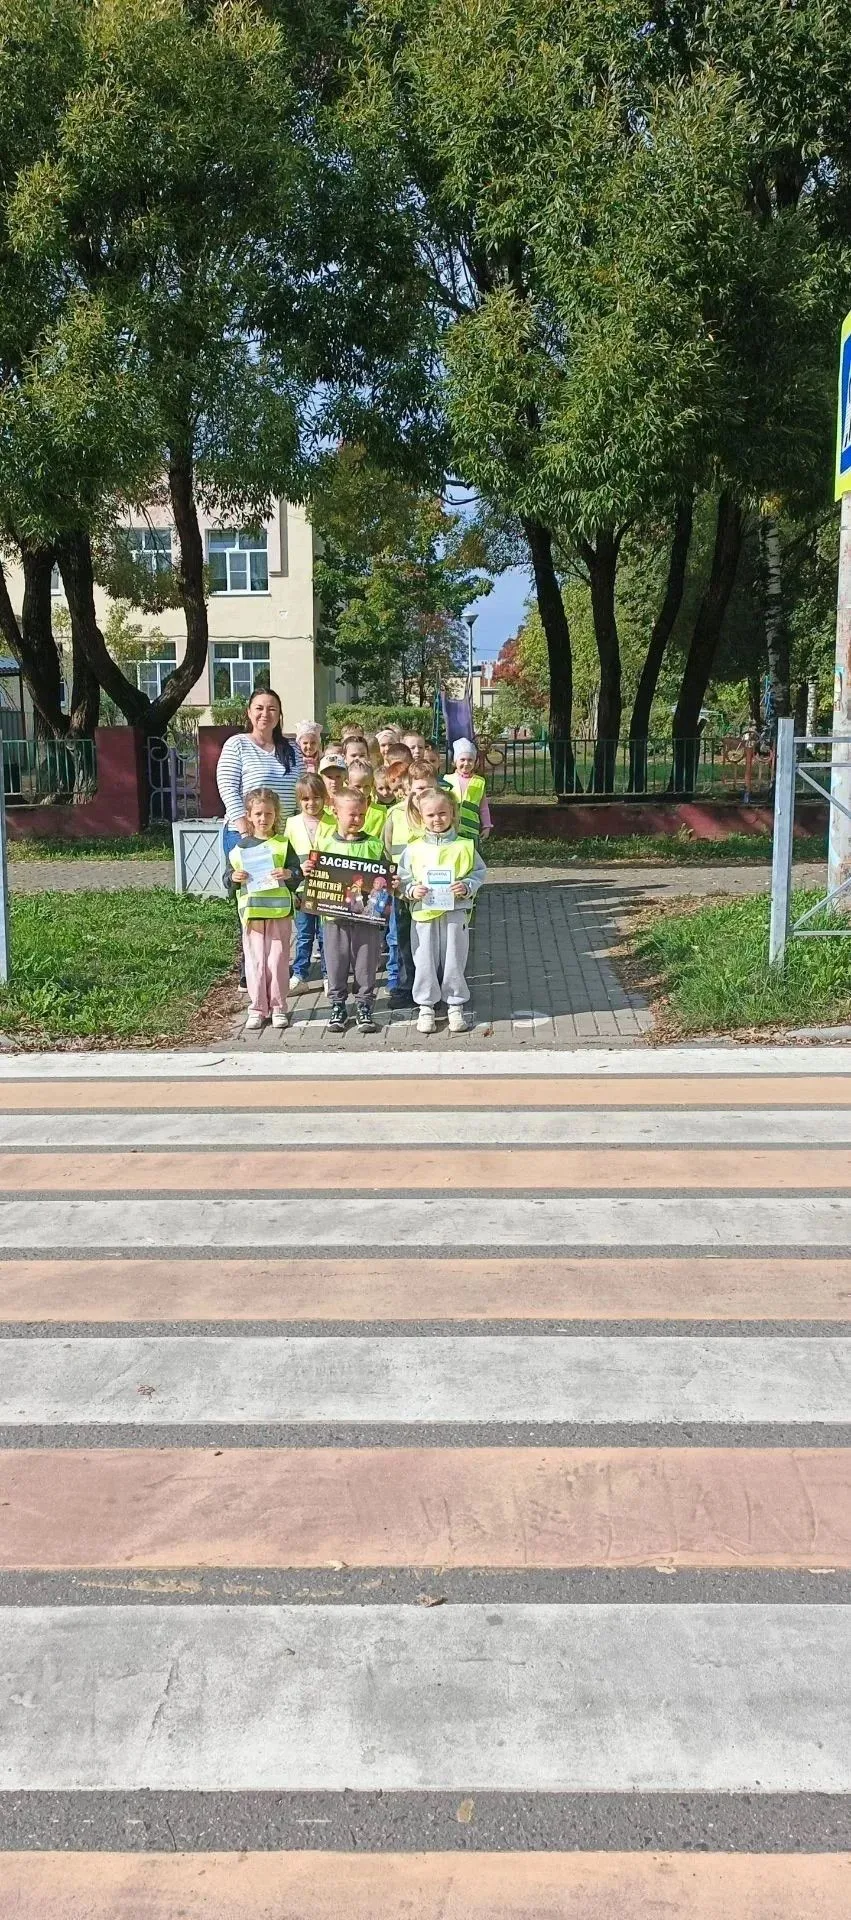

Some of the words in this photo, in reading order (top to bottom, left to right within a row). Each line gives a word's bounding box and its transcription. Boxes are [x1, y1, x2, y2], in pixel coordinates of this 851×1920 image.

[320, 856, 386, 874] ЗАСВЕТИСЬ
[310, 869, 329, 879] СТАНЬ
[306, 889, 315, 897] НА
[317, 891, 344, 902] ДОРОГЕ!
